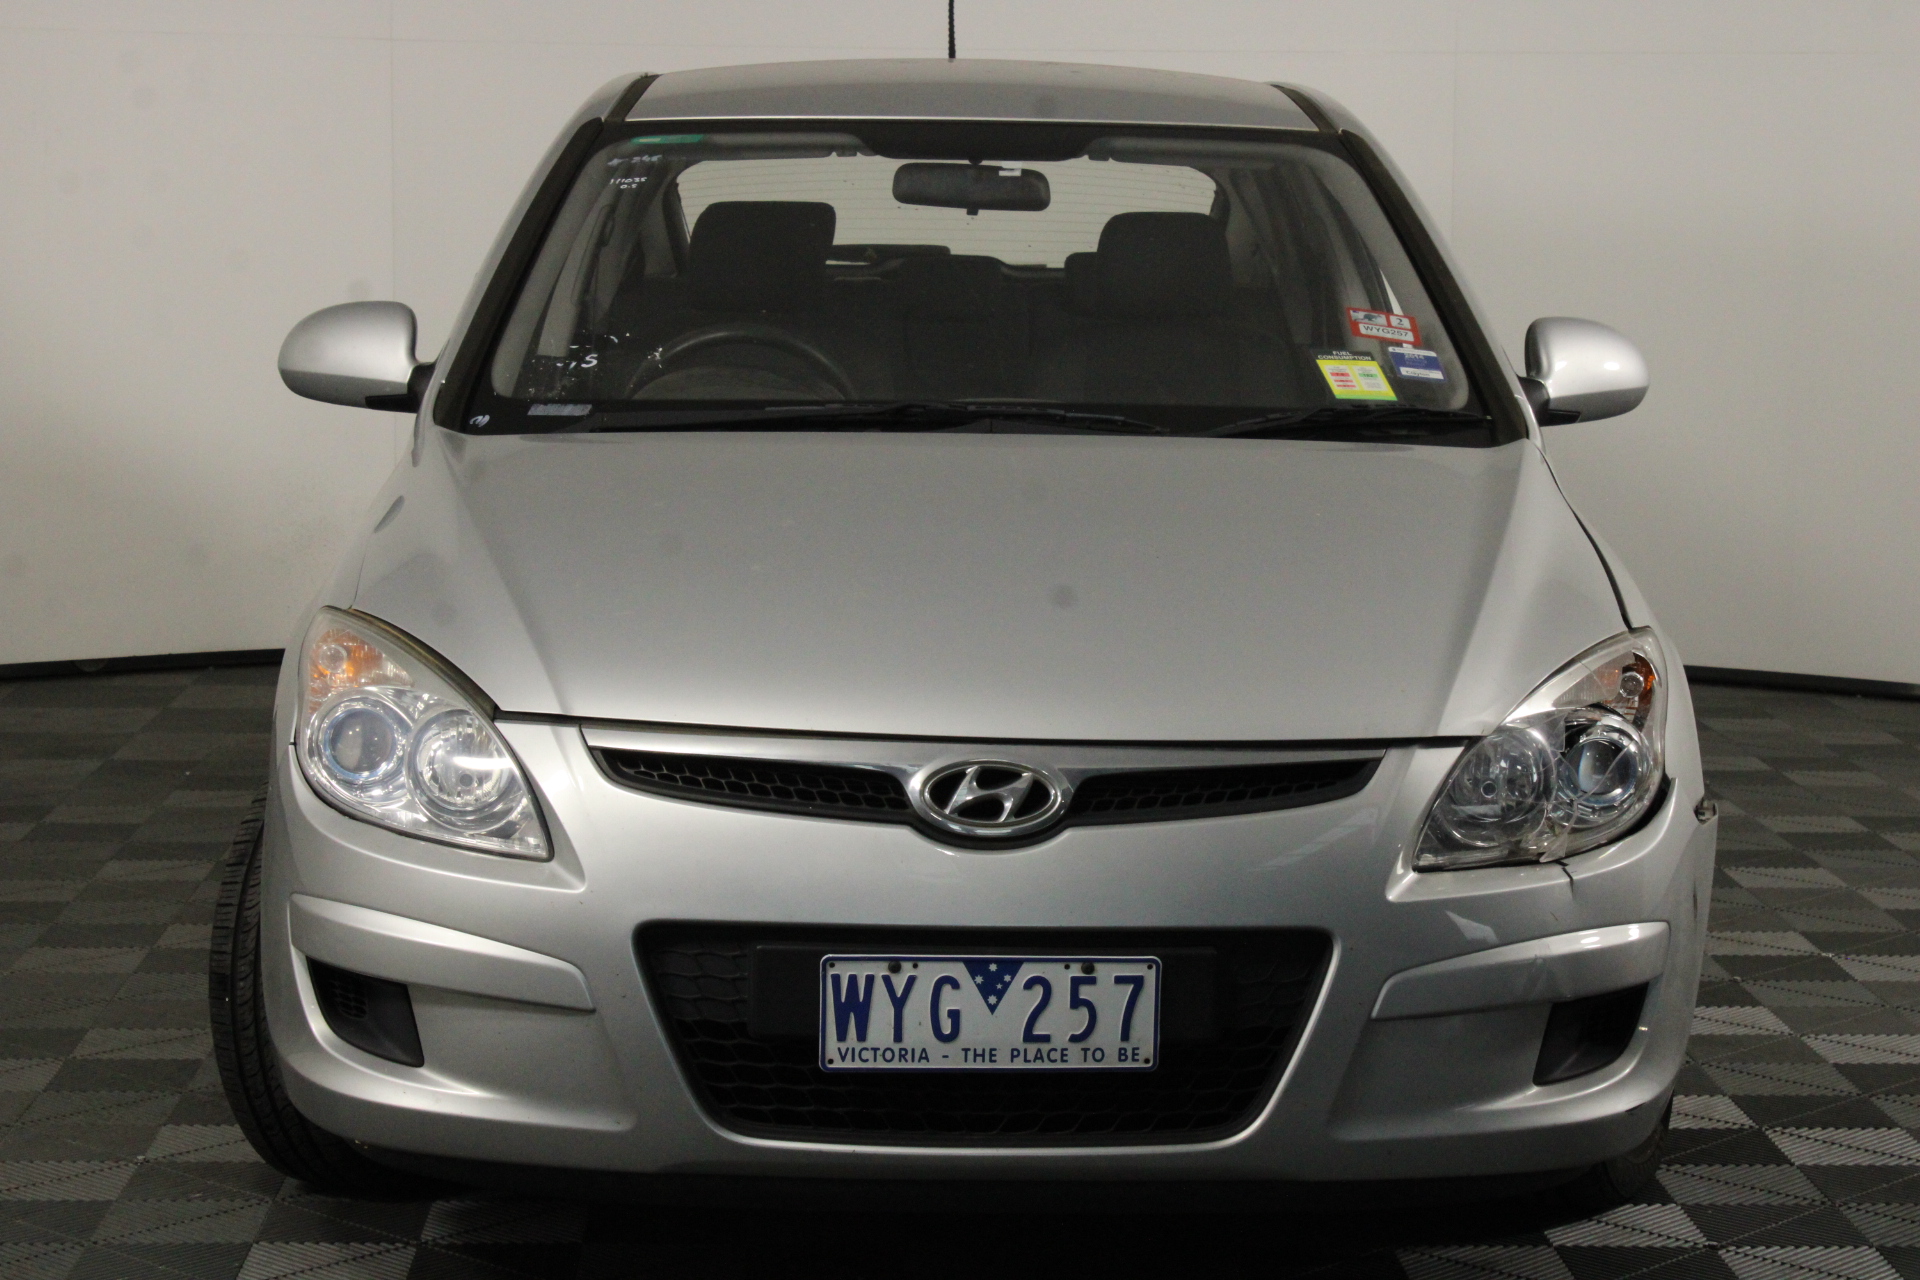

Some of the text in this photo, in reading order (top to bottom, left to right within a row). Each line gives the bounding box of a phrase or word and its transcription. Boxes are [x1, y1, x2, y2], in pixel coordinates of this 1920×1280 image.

[1396, 318, 1404, 326] 2
[1363, 325, 1409, 337] WYG257
[831, 974, 1145, 1044] WYG 257
[837, 1047, 930, 1063] VICTORIA
[962, 1047, 997, 1063] THE
[1010, 1047, 1069, 1063] PLACE
[1081, 1047, 1105, 1063] TO
[1118, 1047, 1141, 1063] BE
